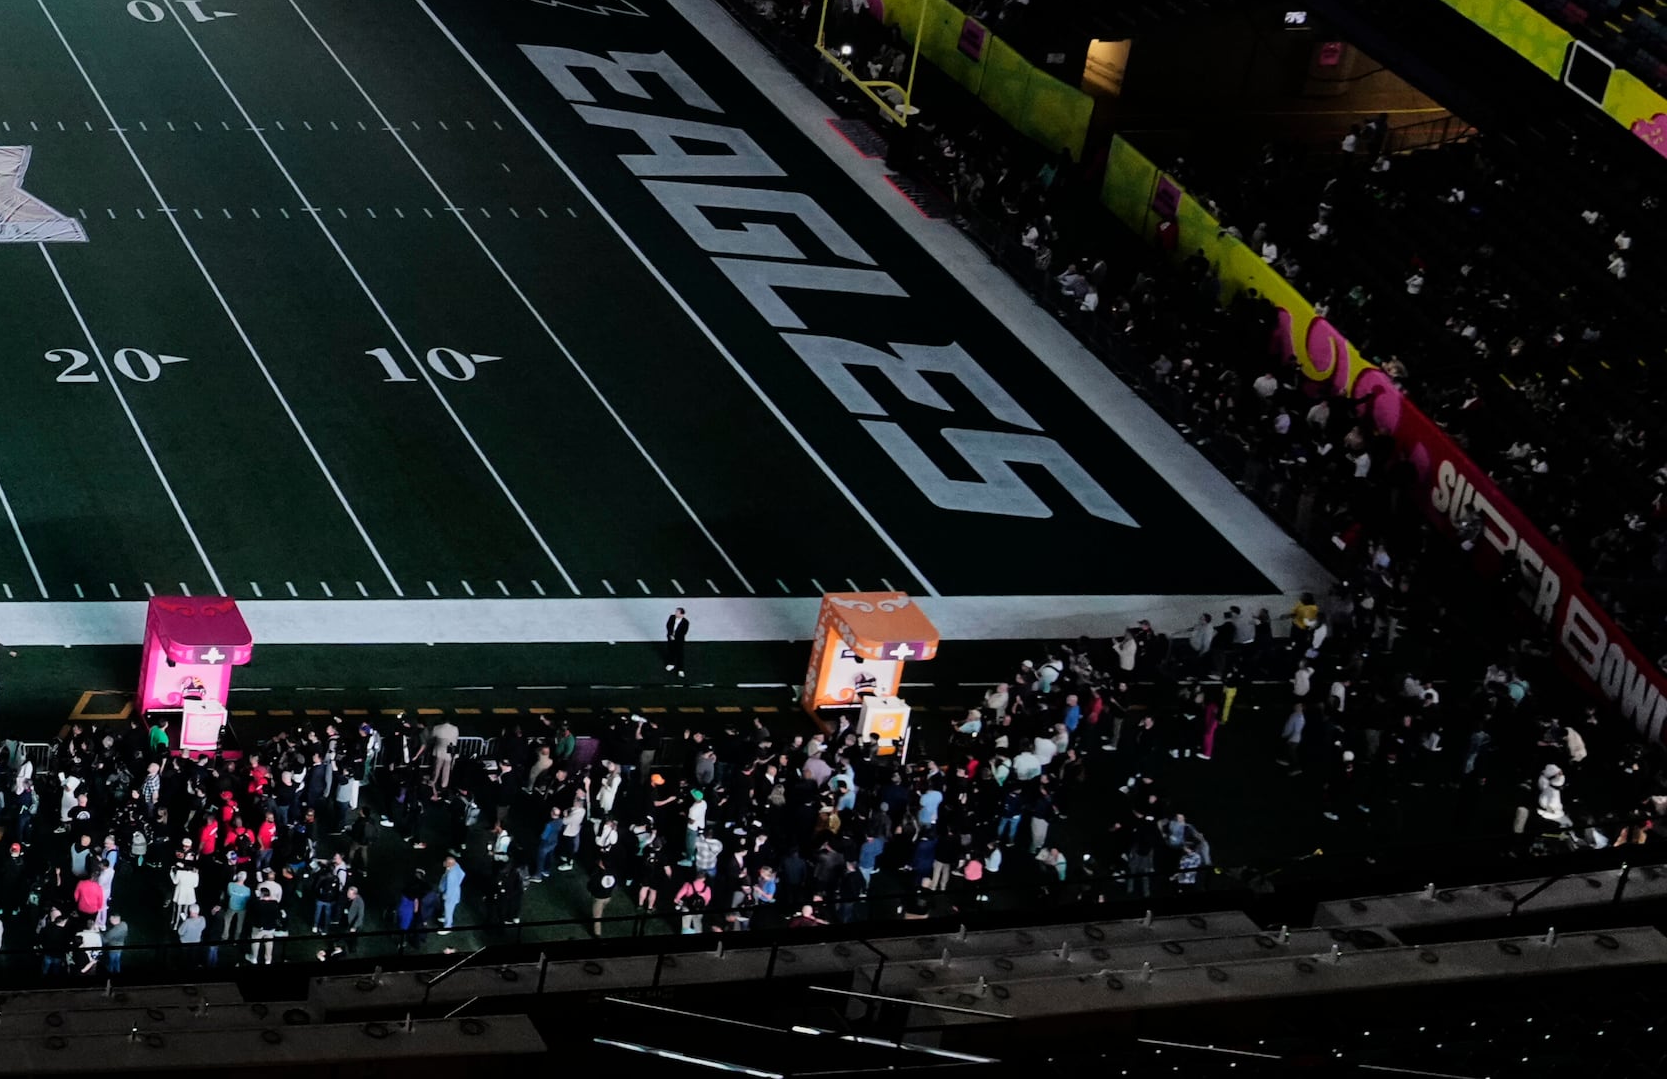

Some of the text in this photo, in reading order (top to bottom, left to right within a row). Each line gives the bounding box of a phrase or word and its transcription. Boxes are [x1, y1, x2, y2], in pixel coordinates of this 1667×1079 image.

[127, 0, 214, 22] 10
[517, 44, 1142, 528] EAGLES
[45, 348, 161, 382] 20
[365, 347, 475, 382] 10
